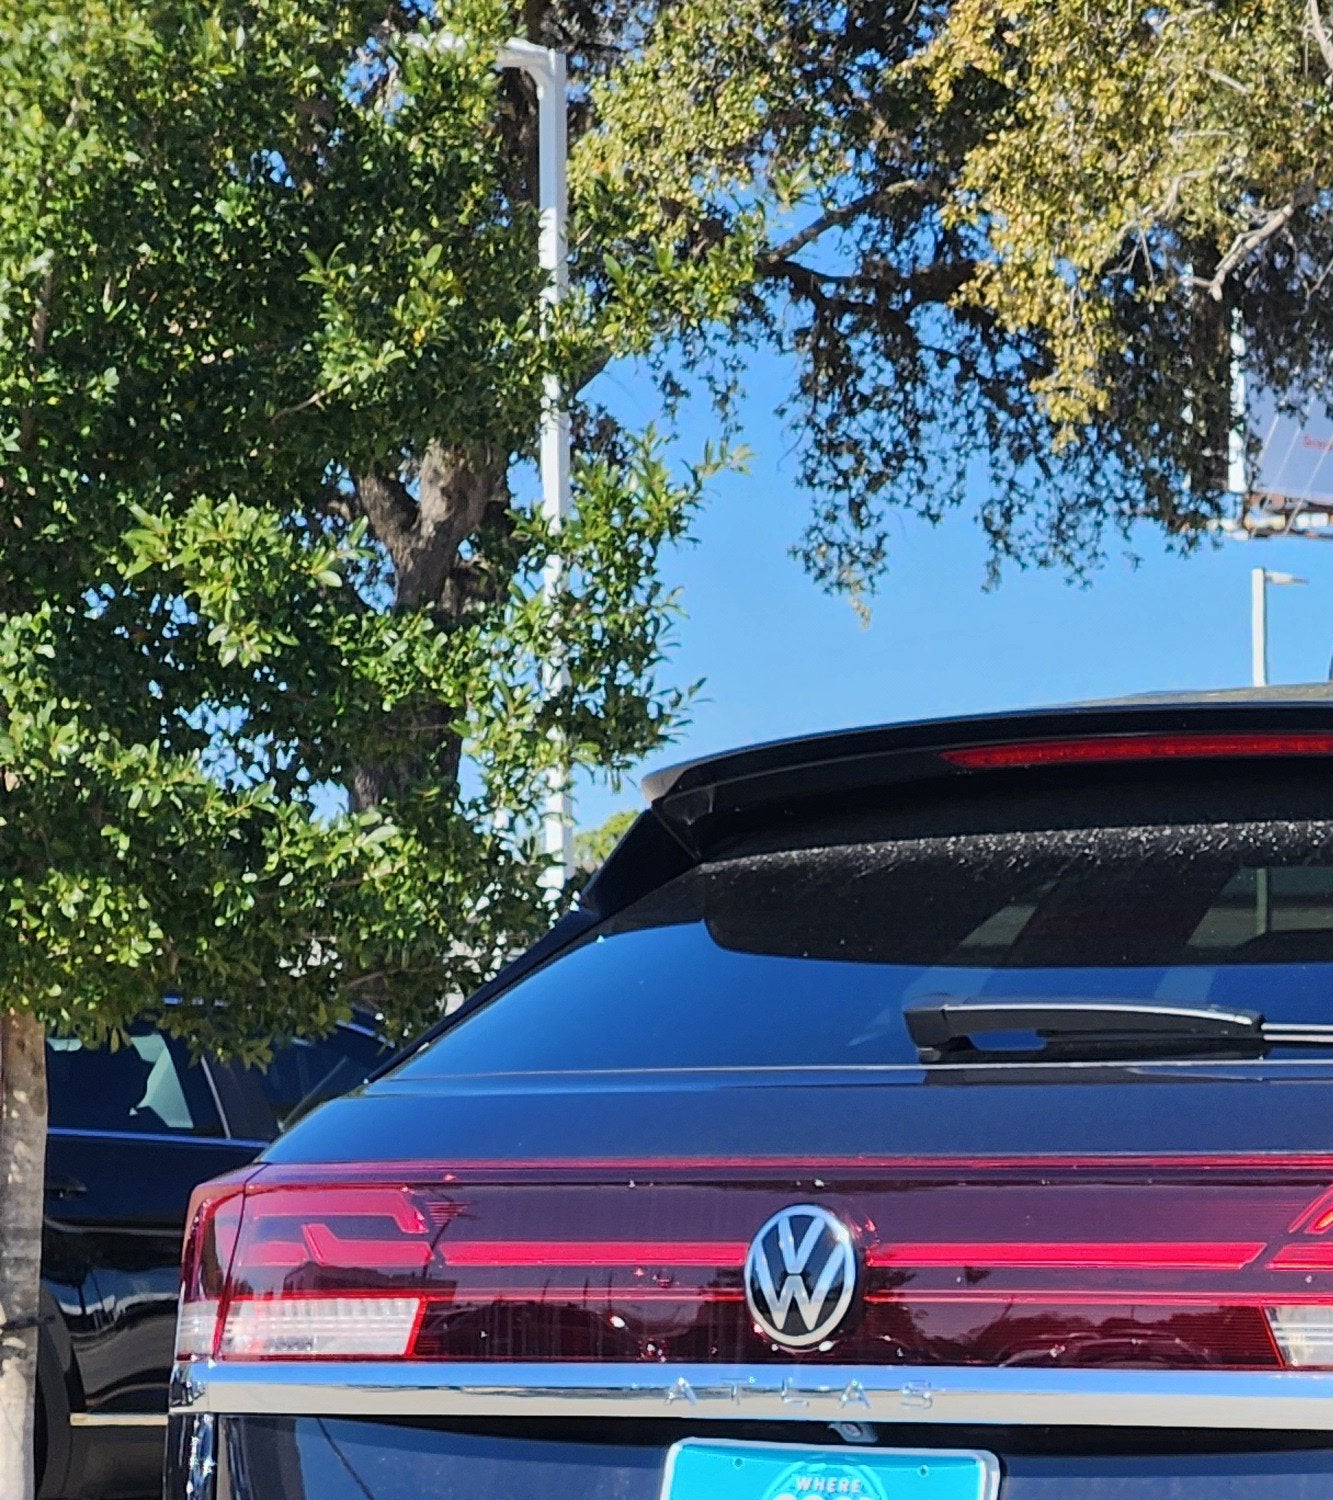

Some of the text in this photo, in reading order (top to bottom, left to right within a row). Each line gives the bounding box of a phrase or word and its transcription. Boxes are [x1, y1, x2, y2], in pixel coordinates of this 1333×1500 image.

[745, 1204, 856, 1347] VW
[664, 1377, 935, 1410] ATLAS
[795, 1476, 863, 1494] WHERE
